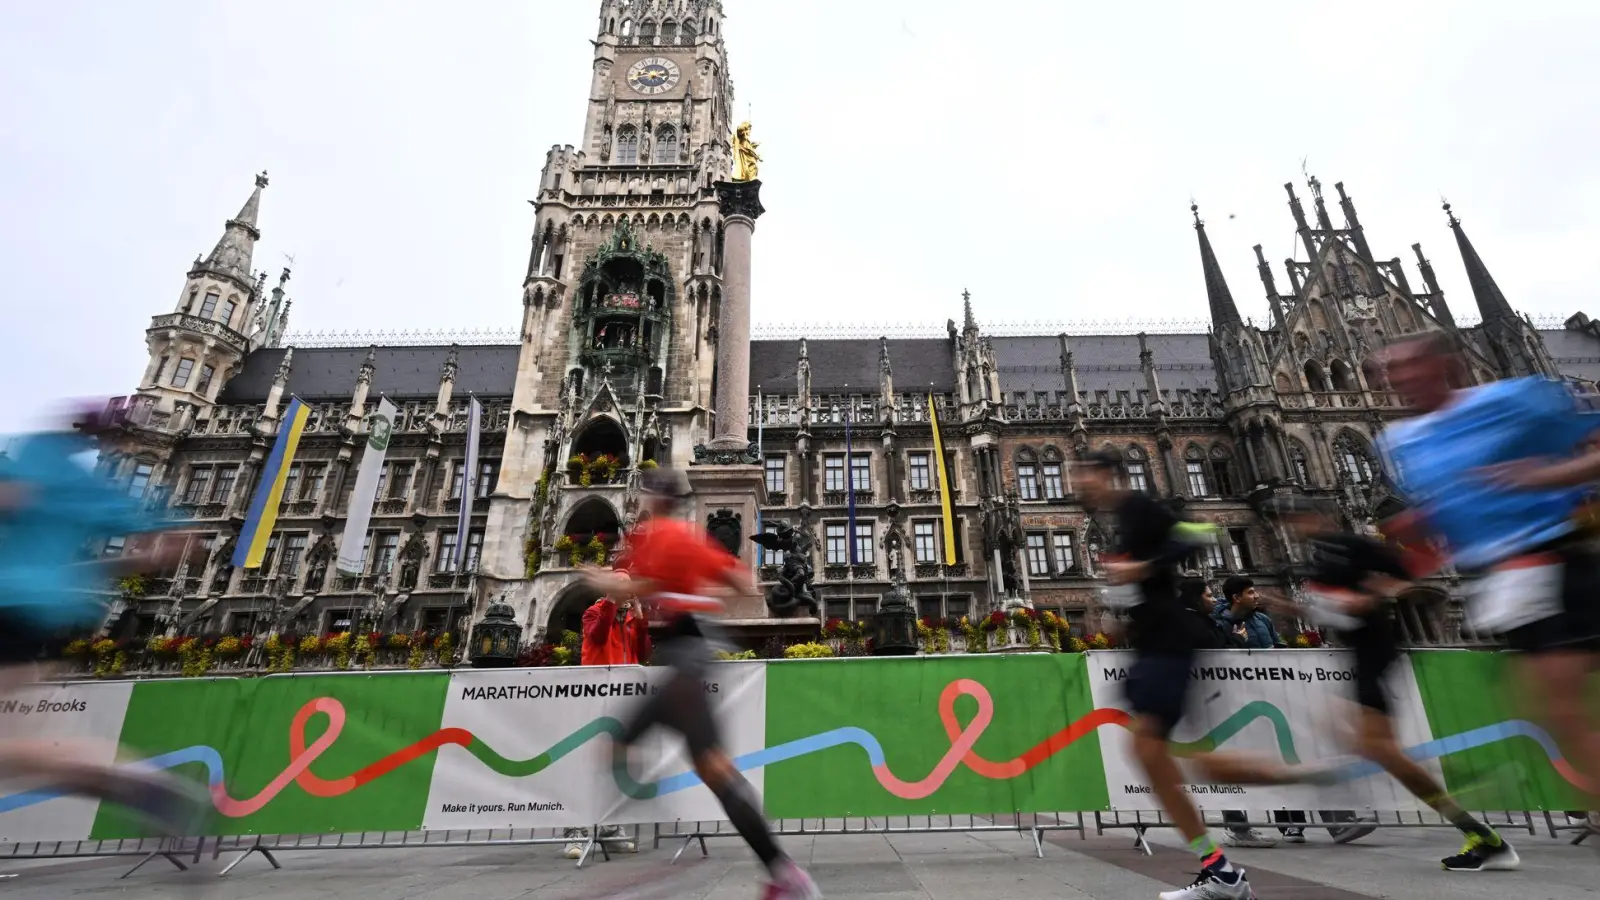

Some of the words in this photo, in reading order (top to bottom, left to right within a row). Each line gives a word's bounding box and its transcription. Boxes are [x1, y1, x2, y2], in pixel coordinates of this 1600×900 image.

[1298, 671, 1313, 683] by
[19, 703, 33, 715] by
[36, 699, 87, 713] Brooks
[1124, 785, 1151, 794] Make
[1191, 785, 1209, 794] Run
[1210, 785, 1246, 794] Munich.
[441, 804, 467, 813] Make
[469, 803, 476, 812] it
[477, 804, 505, 814] yours.
[507, 803, 526, 811] Run
[527, 802, 565, 811] Munich.
